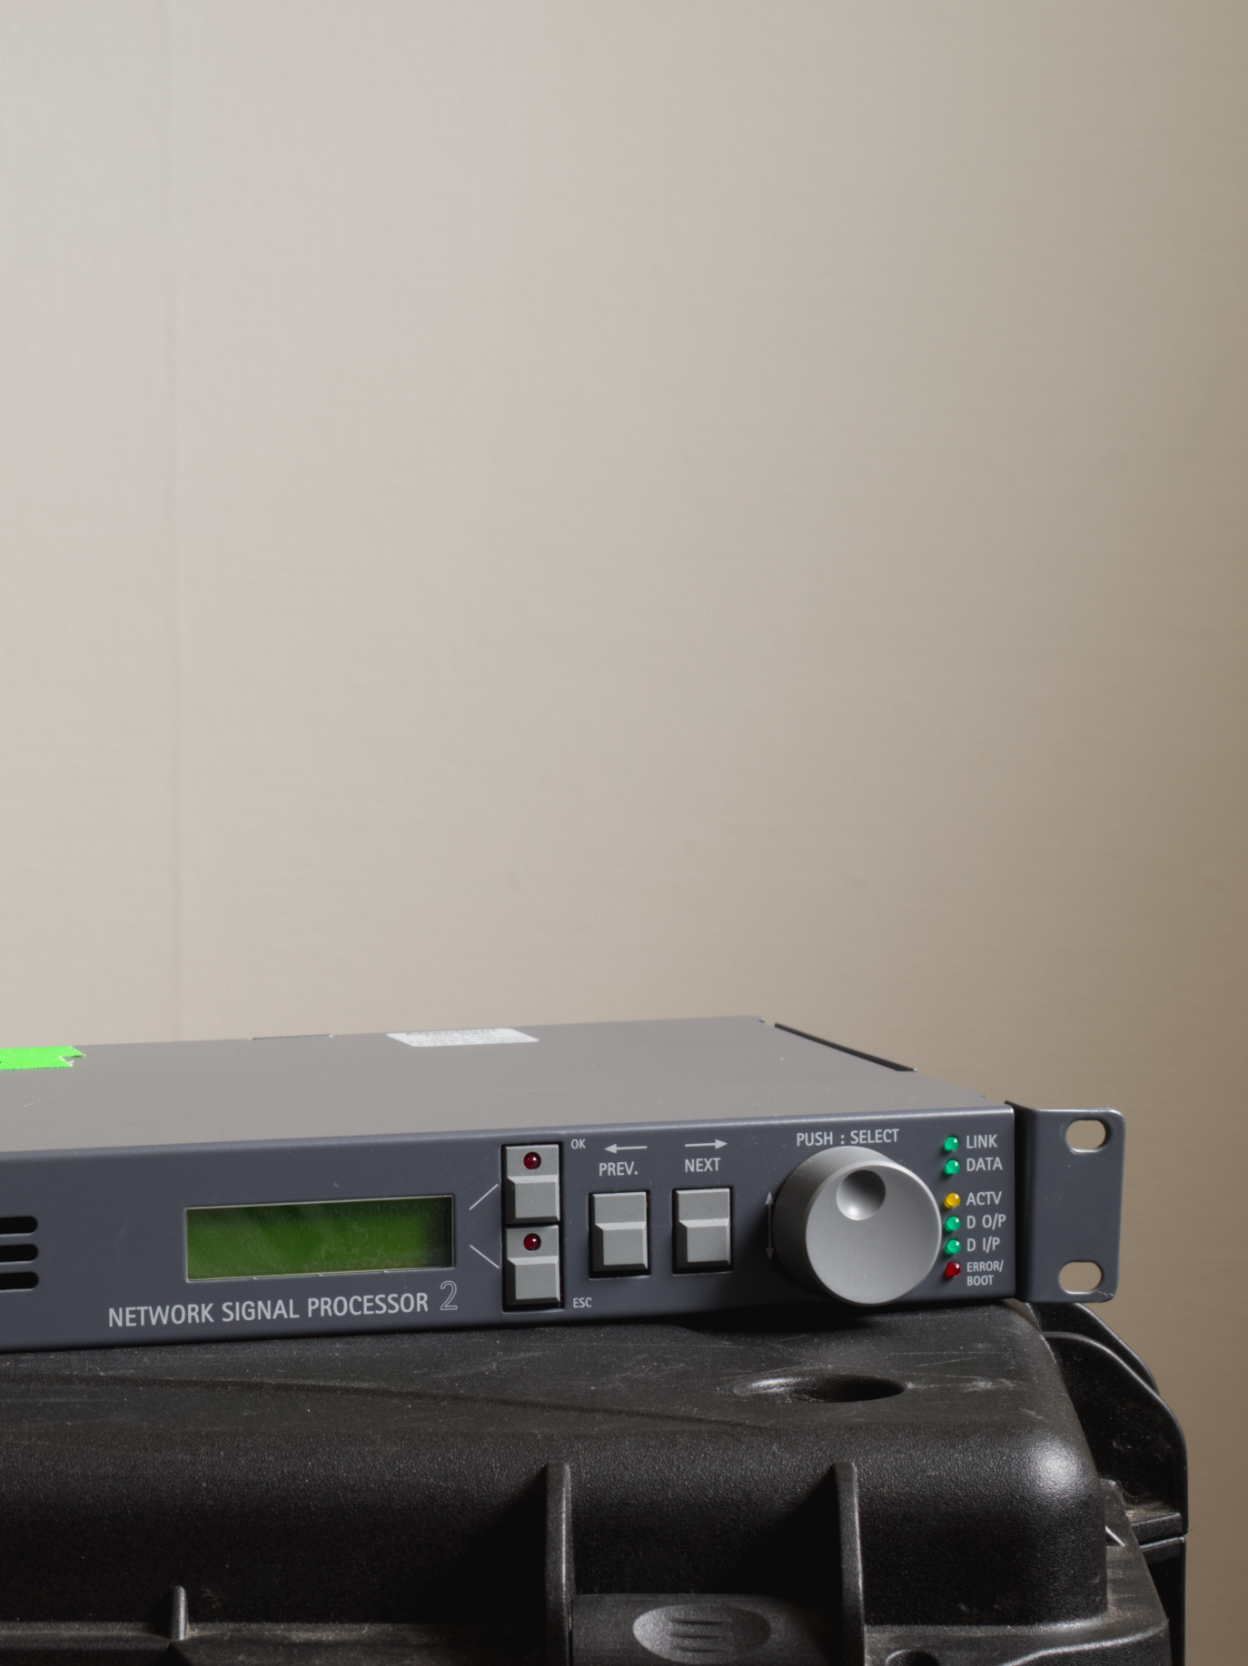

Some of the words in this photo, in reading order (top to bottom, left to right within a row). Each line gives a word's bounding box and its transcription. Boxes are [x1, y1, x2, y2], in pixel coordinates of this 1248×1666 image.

[570, 1138, 587, 1150] OK
[796, 1131, 834, 1147] PUSH
[850, 1128, 901, 1145] SELECT
[965, 1133, 998, 1149] LINK
[598, 1161, 639, 1177] PREV.
[684, 1157, 722, 1173] NEXT
[965, 1156, 1003, 1172] DATA
[965, 1190, 1003, 1206] ACTV
[966, 1215, 977, 1230] D
[981, 1212, 1007, 1231] O/P
[966, 1237, 977, 1252] D
[982, 1235, 1001, 1254] I/P
[966, 1259, 1005, 1273] ERROR/
[966, 1274, 995, 1287] BOOT
[108, 1302, 216, 1328] NETWORK
[221, 1298, 301, 1323] SIGNAL
[307, 1292, 430, 1318] PROCESSOR
[439, 1280, 459, 1312] 2
[572, 1297, 593, 1310] ESC
